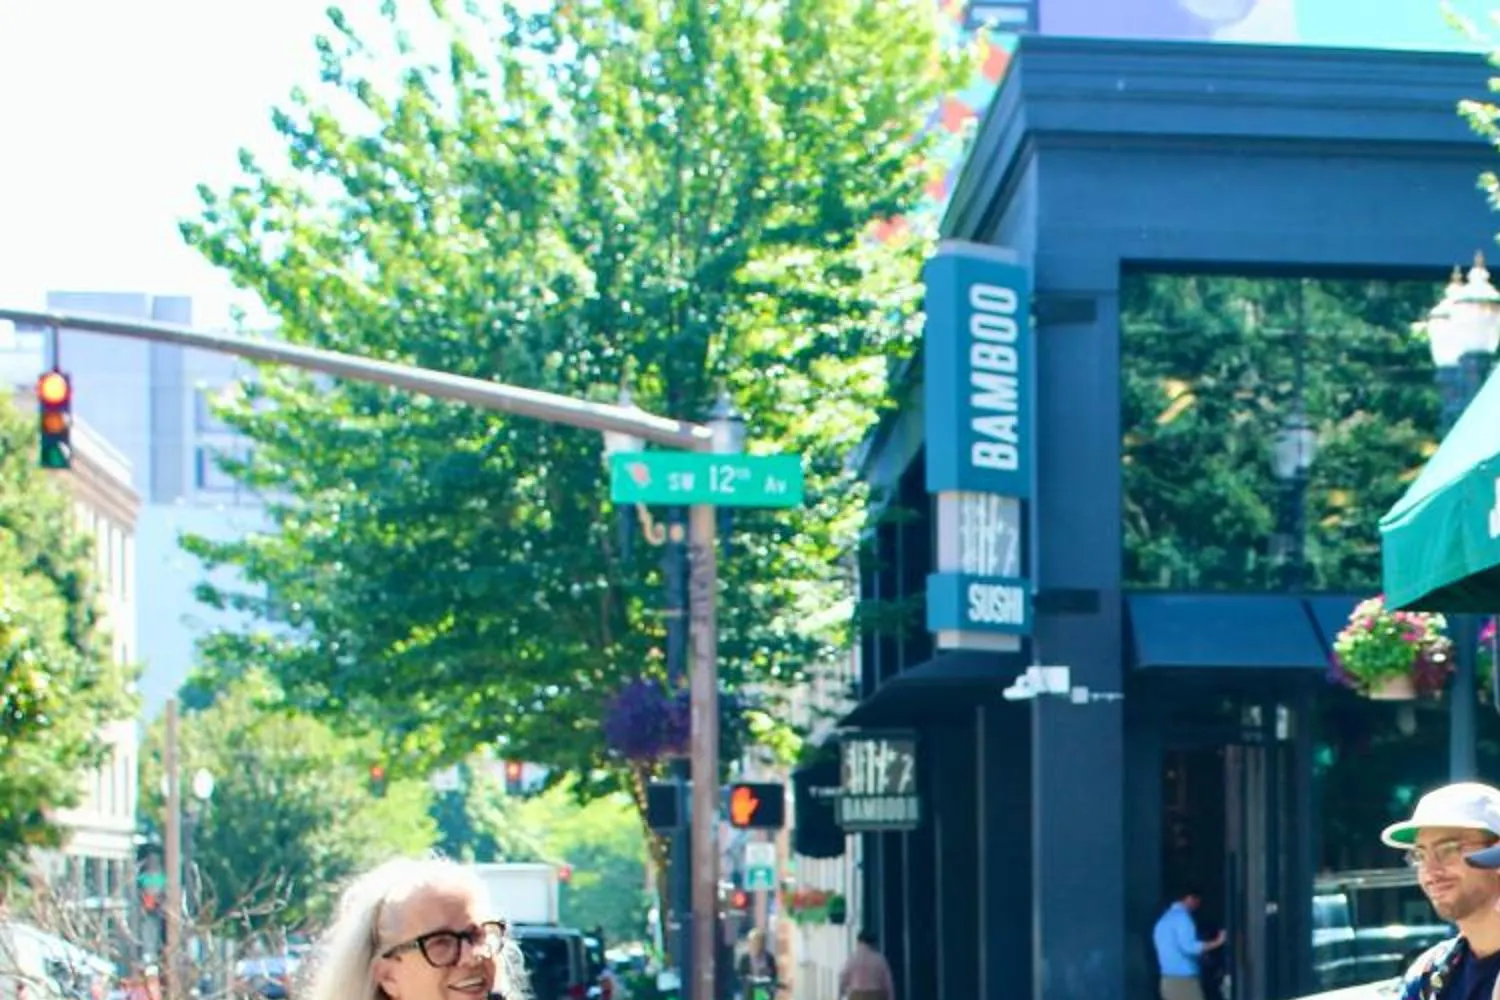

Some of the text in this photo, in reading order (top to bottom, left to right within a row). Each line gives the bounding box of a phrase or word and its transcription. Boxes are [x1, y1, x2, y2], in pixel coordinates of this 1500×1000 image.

[969, 282, 1019, 471] BAMBOO
[667, 472, 696, 492] SW
[967, 582, 1025, 625] SUSHI
